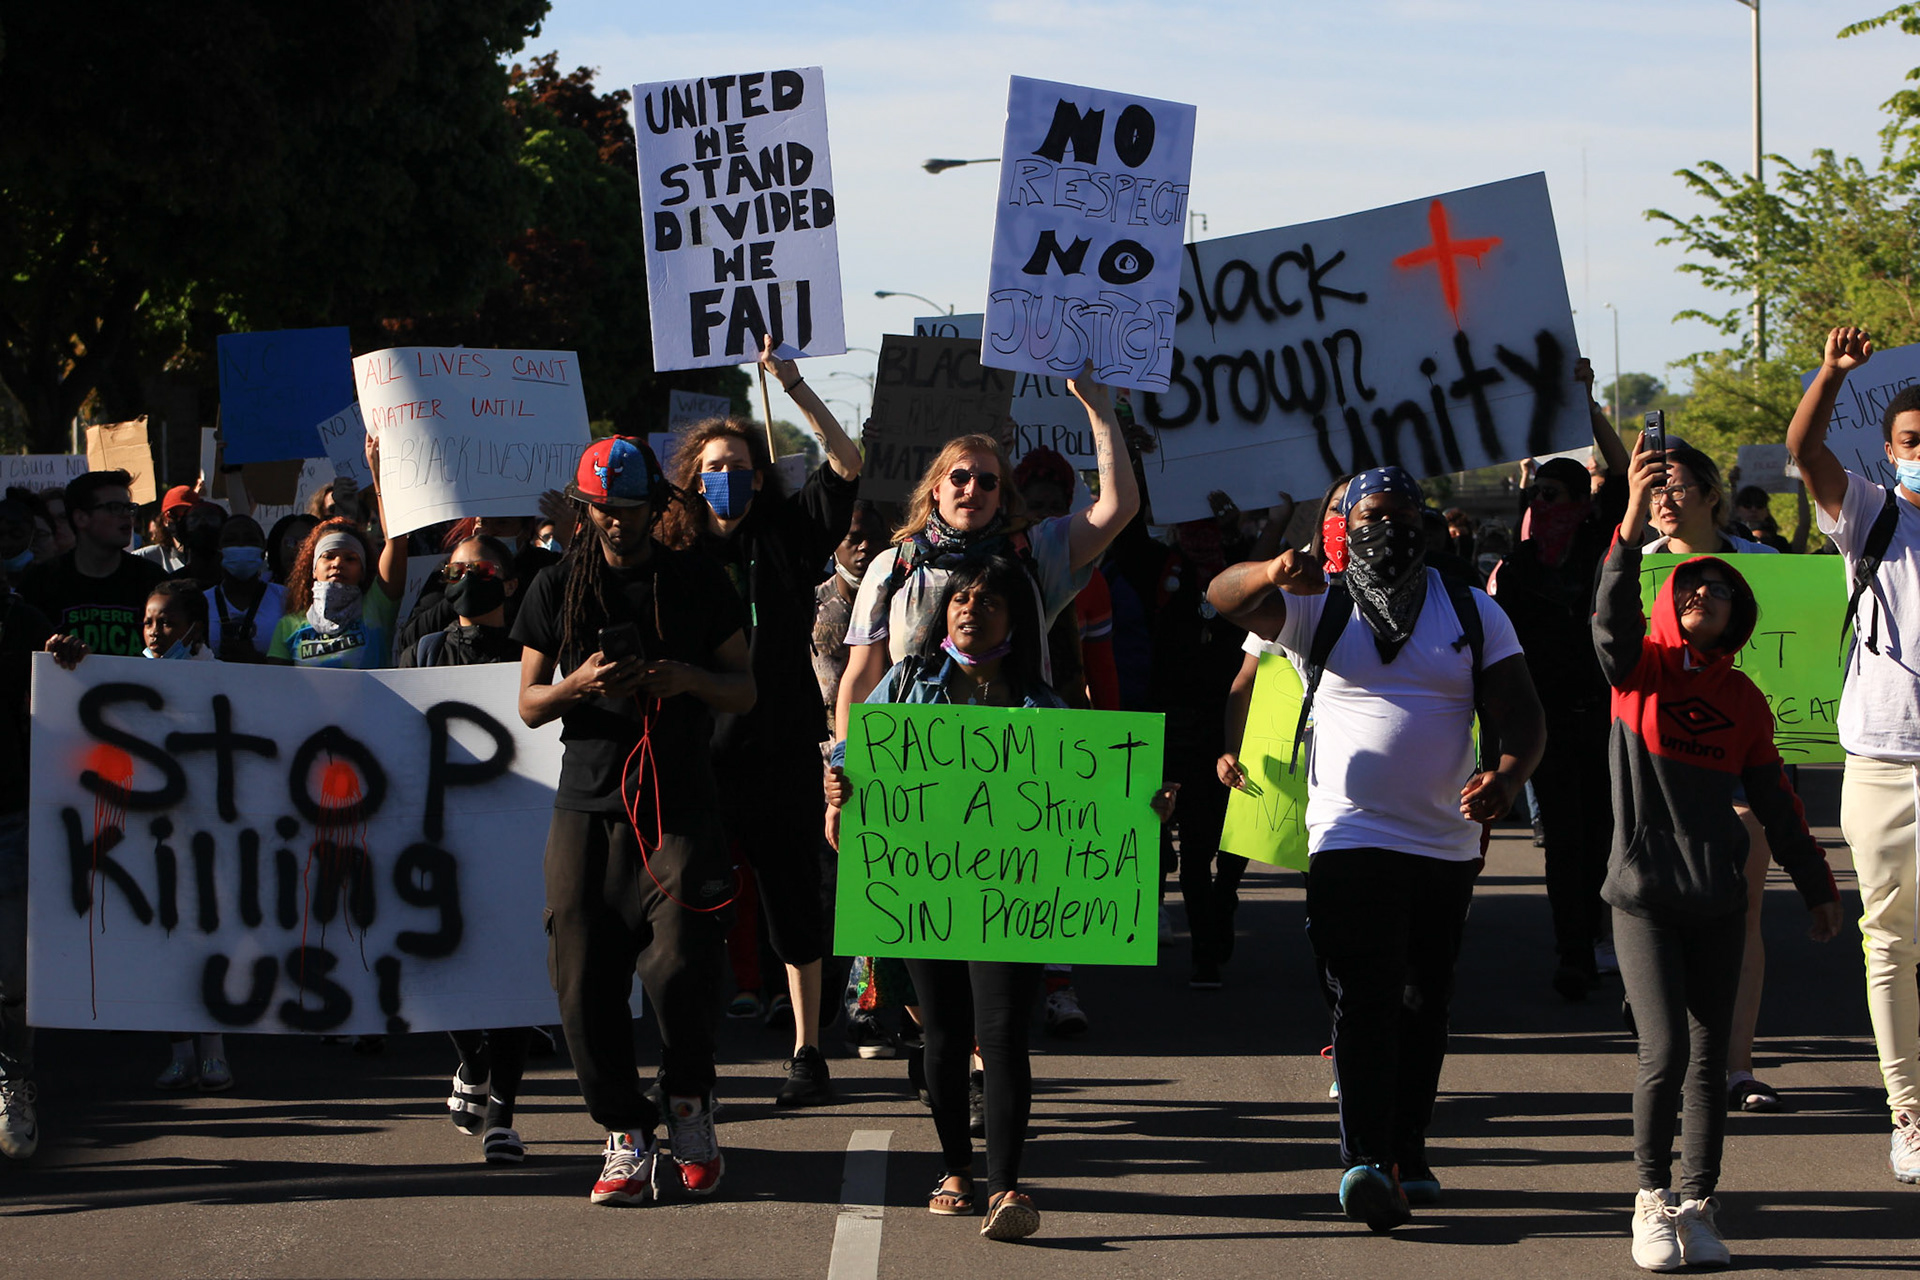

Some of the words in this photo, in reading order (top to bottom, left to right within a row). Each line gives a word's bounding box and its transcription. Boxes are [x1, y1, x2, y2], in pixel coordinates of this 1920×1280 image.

[645, 70, 804, 134] UNITED
[695, 123, 749, 159] WE
[1032, 98, 1155, 168] NO
[660, 142, 814, 205] STAND
[1009, 159, 1189, 226] RESPECT
[654, 188, 835, 252] DIVIDED
[713, 241, 777, 282] WE
[1022, 230, 1154, 284] NO
[990, 288, 1174, 387] JUSTICE
[364, 358, 402, 389] ALL
[417, 352, 491, 378] LIVES
[882, 345, 1006, 392] BLACK
[321, 416, 346, 445] NO
[373, 399, 447, 431] MATTER
[471, 397, 535, 417] UNTIL
[382, 434, 591, 494] #BLACKLIVESMATTE
[1059, 728, 1097, 778] is
[1660, 734, 1726, 760] umbro
[964, 781, 994, 827] A
[856, 831, 1039, 884] Problem
